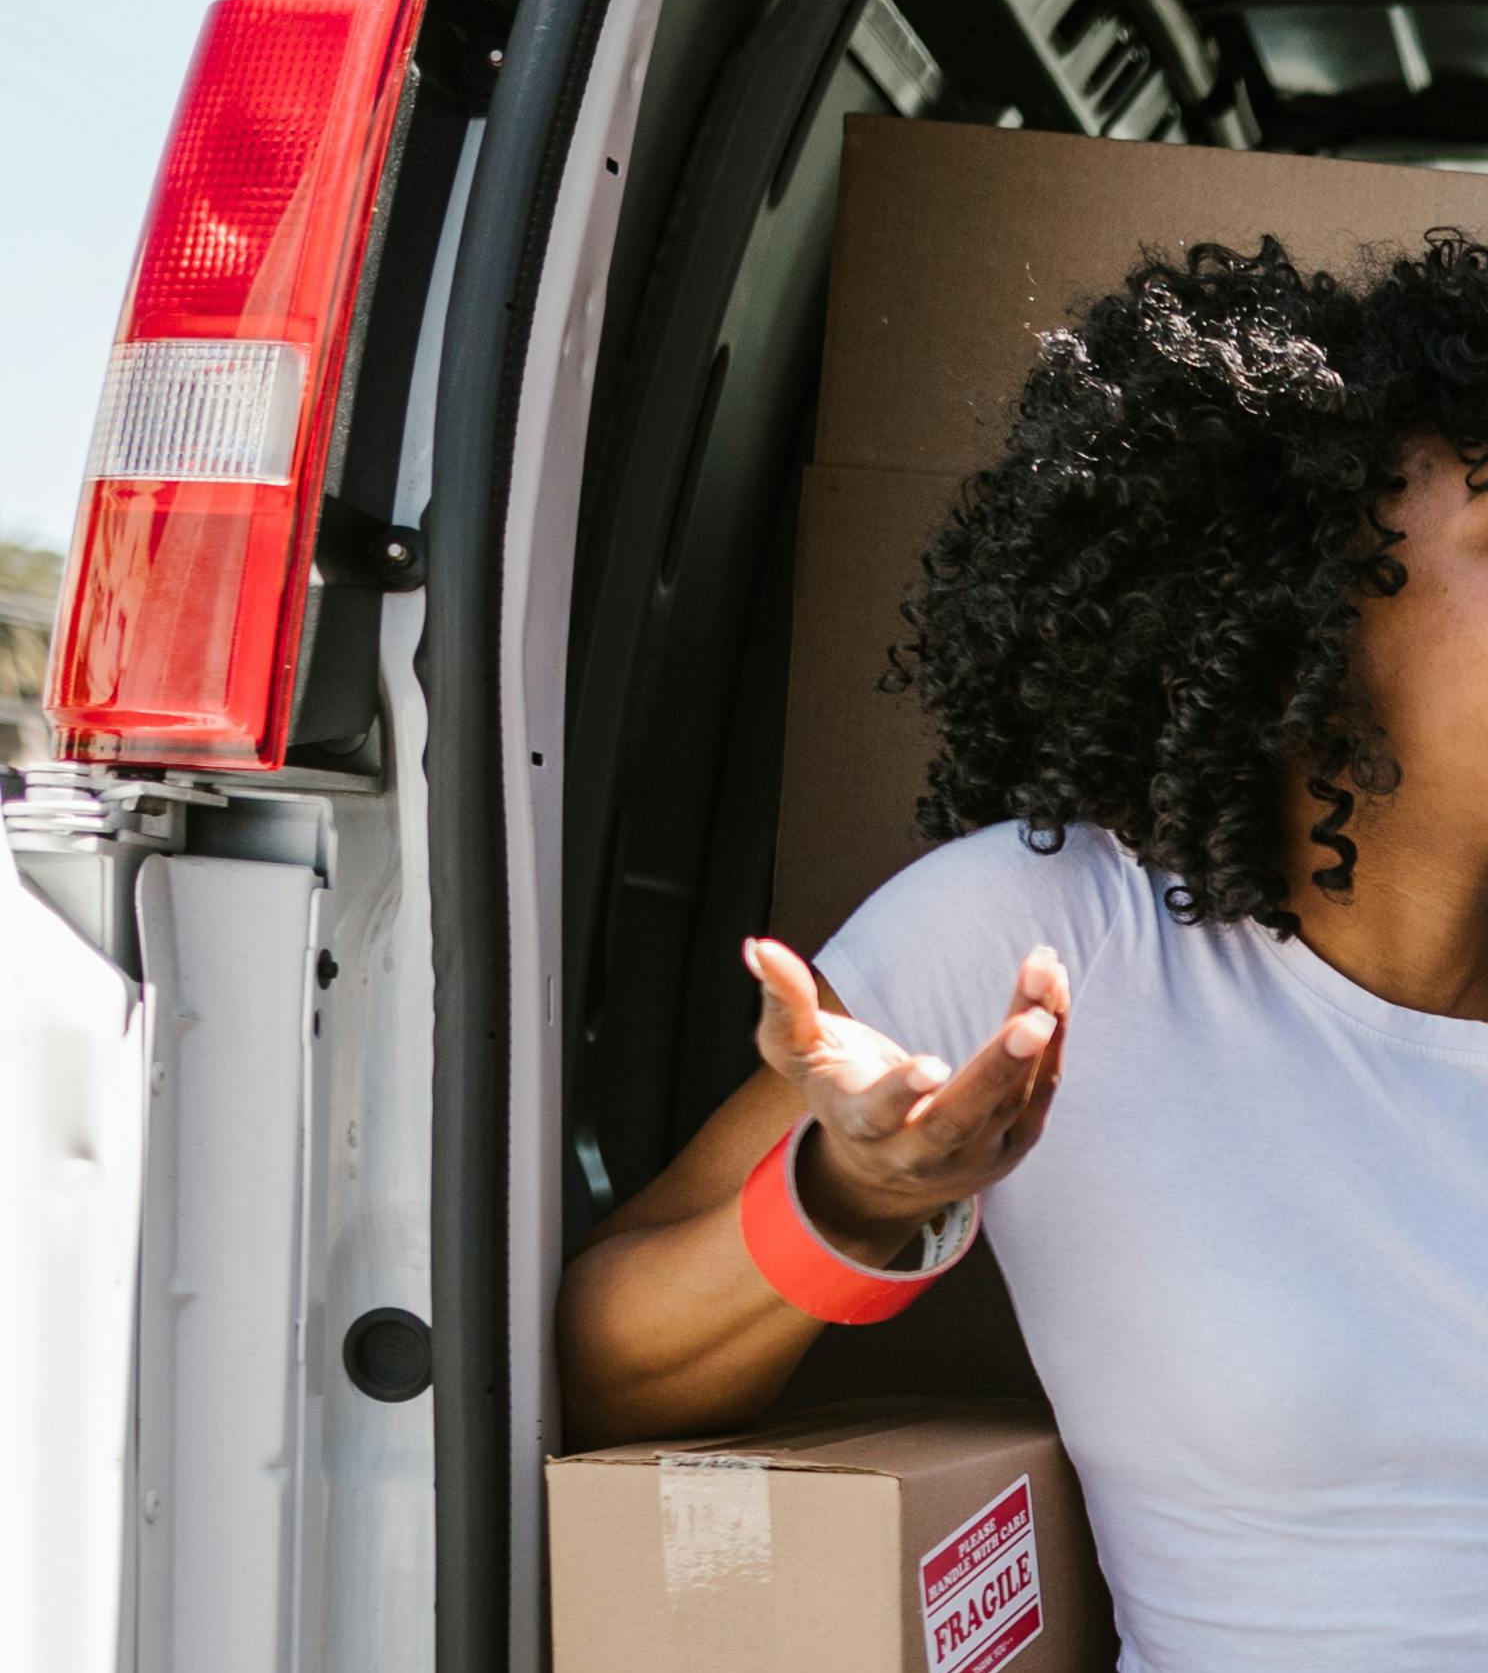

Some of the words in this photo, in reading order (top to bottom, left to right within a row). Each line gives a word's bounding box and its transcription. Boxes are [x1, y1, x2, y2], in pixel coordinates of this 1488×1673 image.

[928, 1559, 971, 1602] HANDLE
[972, 1533, 1000, 1565] WITH
[1000, 1509, 1028, 1542] CARE
[958, 1517, 997, 1558] PLEASE
[933, 1551, 1032, 1664] FRAGILE
